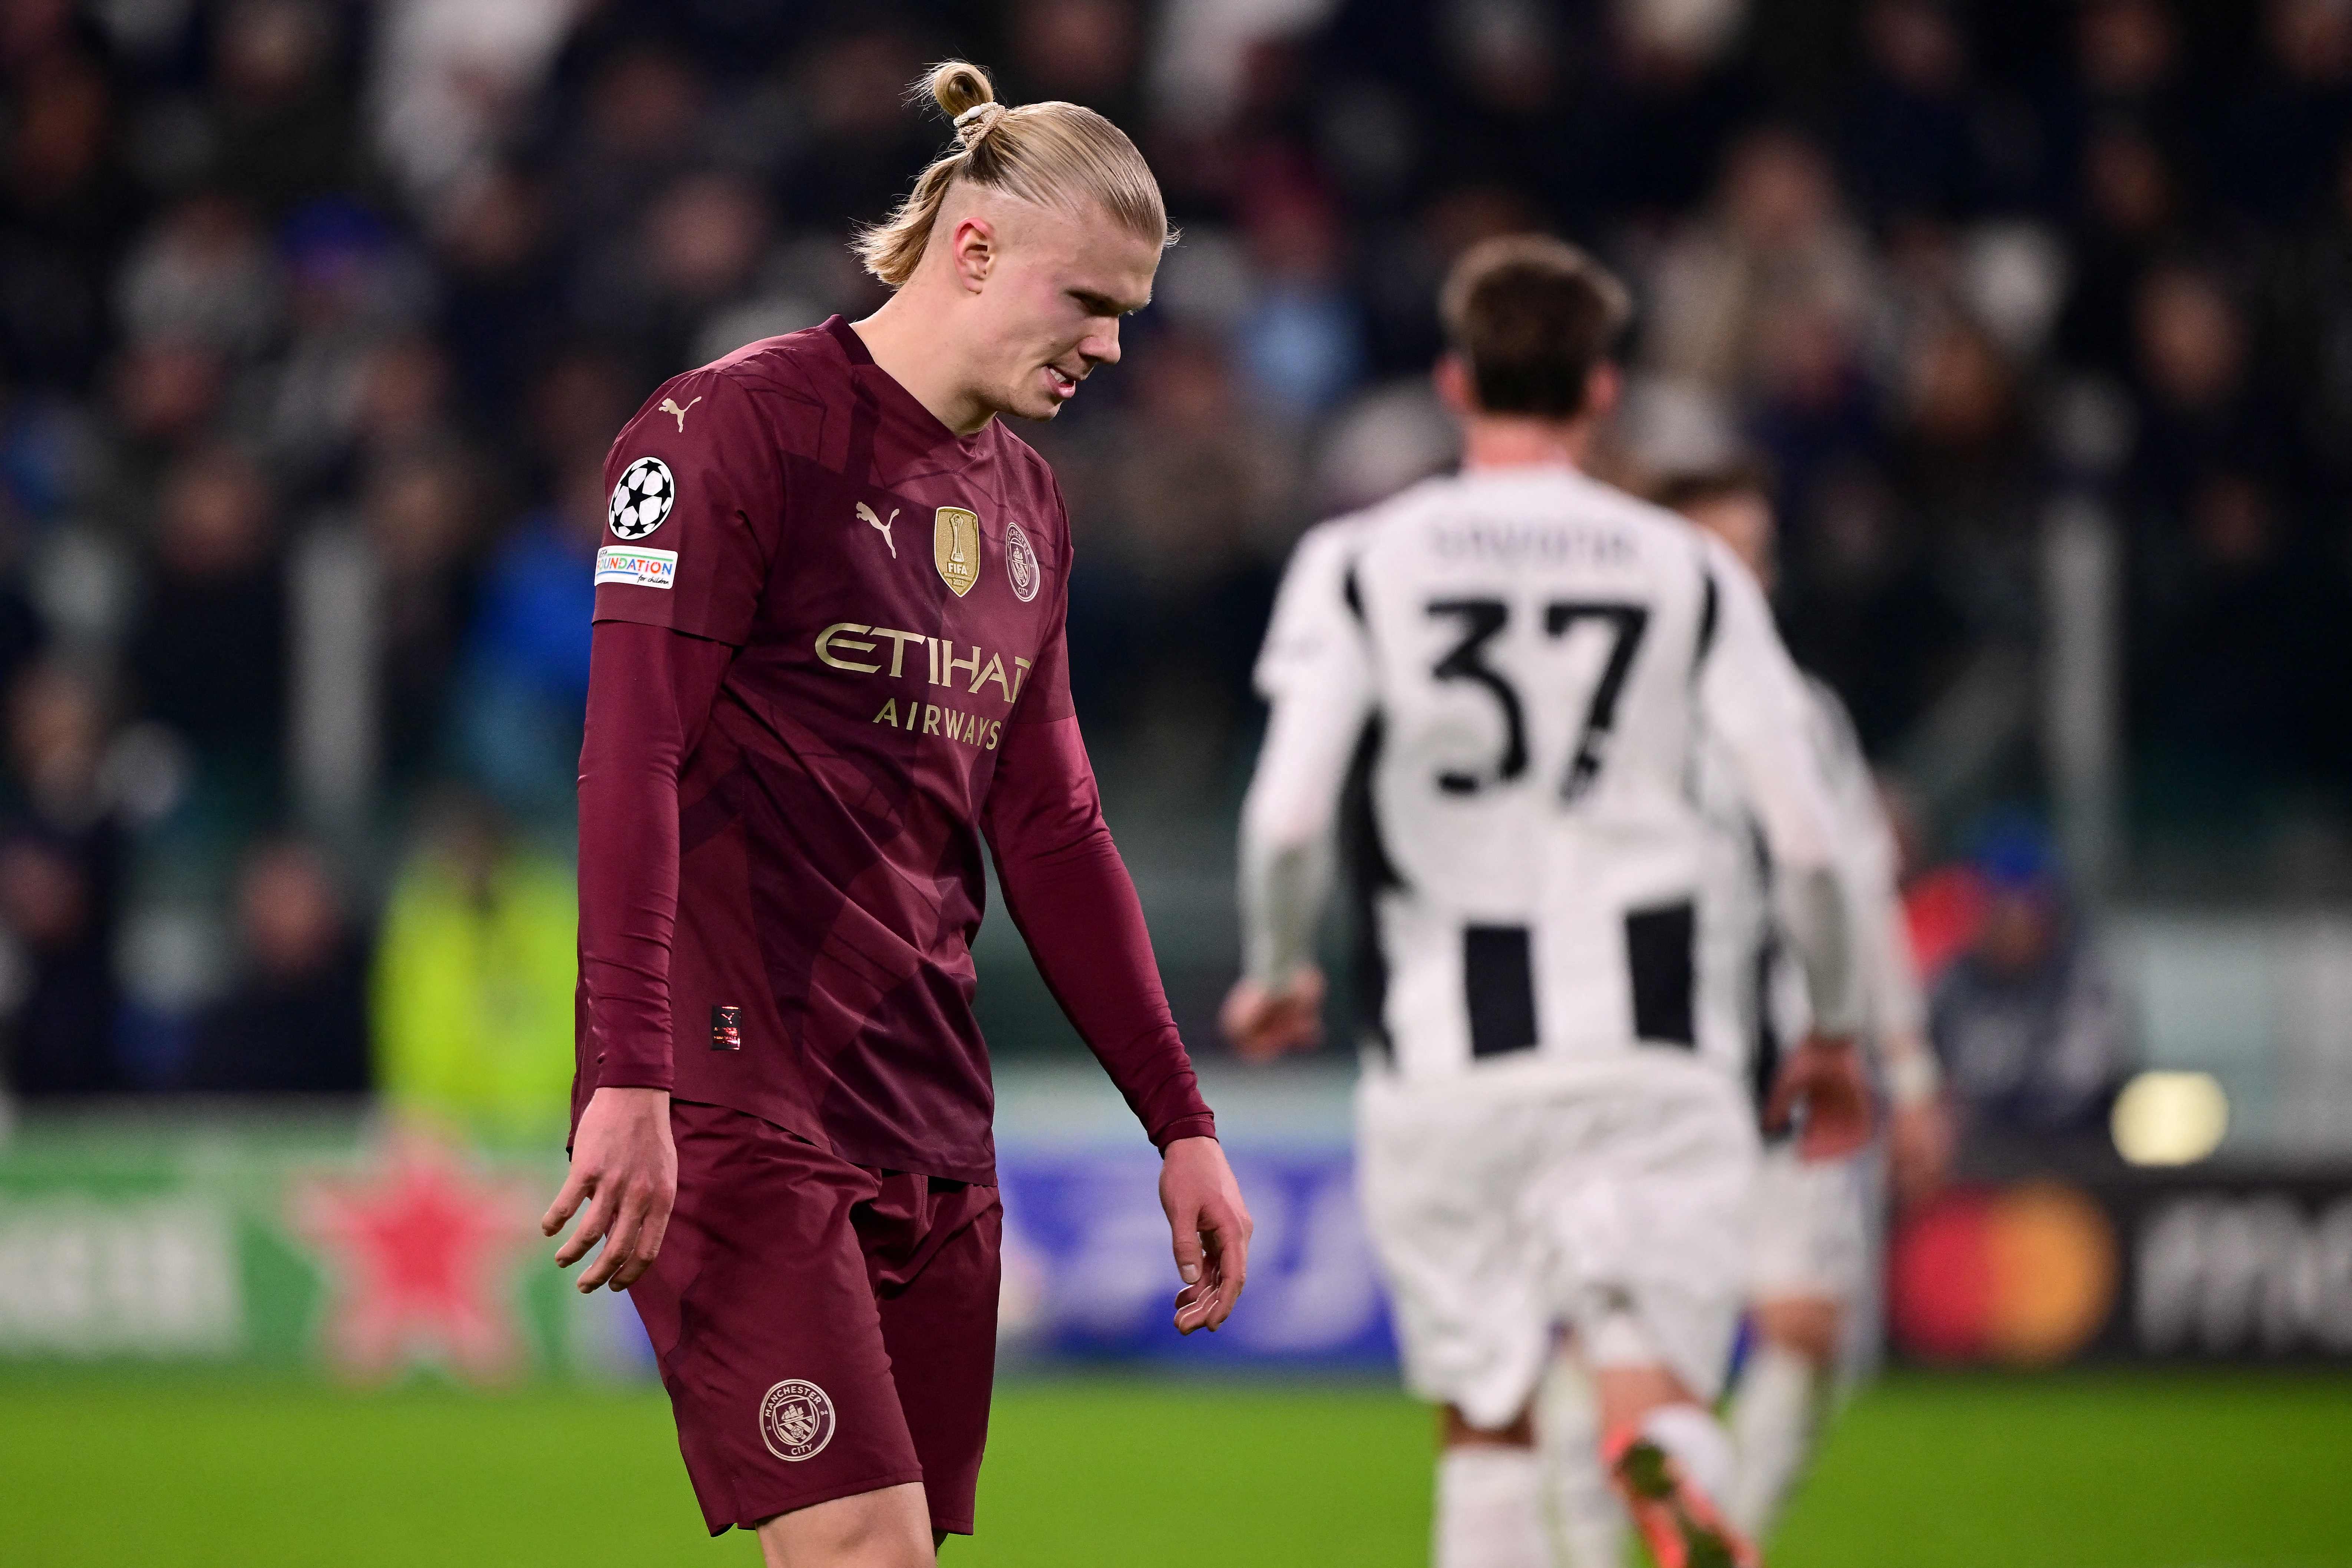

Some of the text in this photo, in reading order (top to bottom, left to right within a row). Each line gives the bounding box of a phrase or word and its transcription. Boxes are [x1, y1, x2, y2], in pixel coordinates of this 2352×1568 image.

[1007, 529, 1030, 555] MANCHESTER
[948, 562, 968, 575] FIFA
[638, 575, 669, 585] for children
[1018, 587, 1028, 596] CITY
[1426, 598, 1650, 799] 37
[872, 698, 1001, 750] AIRWAYS
[765, 1386, 822, 1418] MANCHESTER
[790, 1443, 813, 1455] CITY
